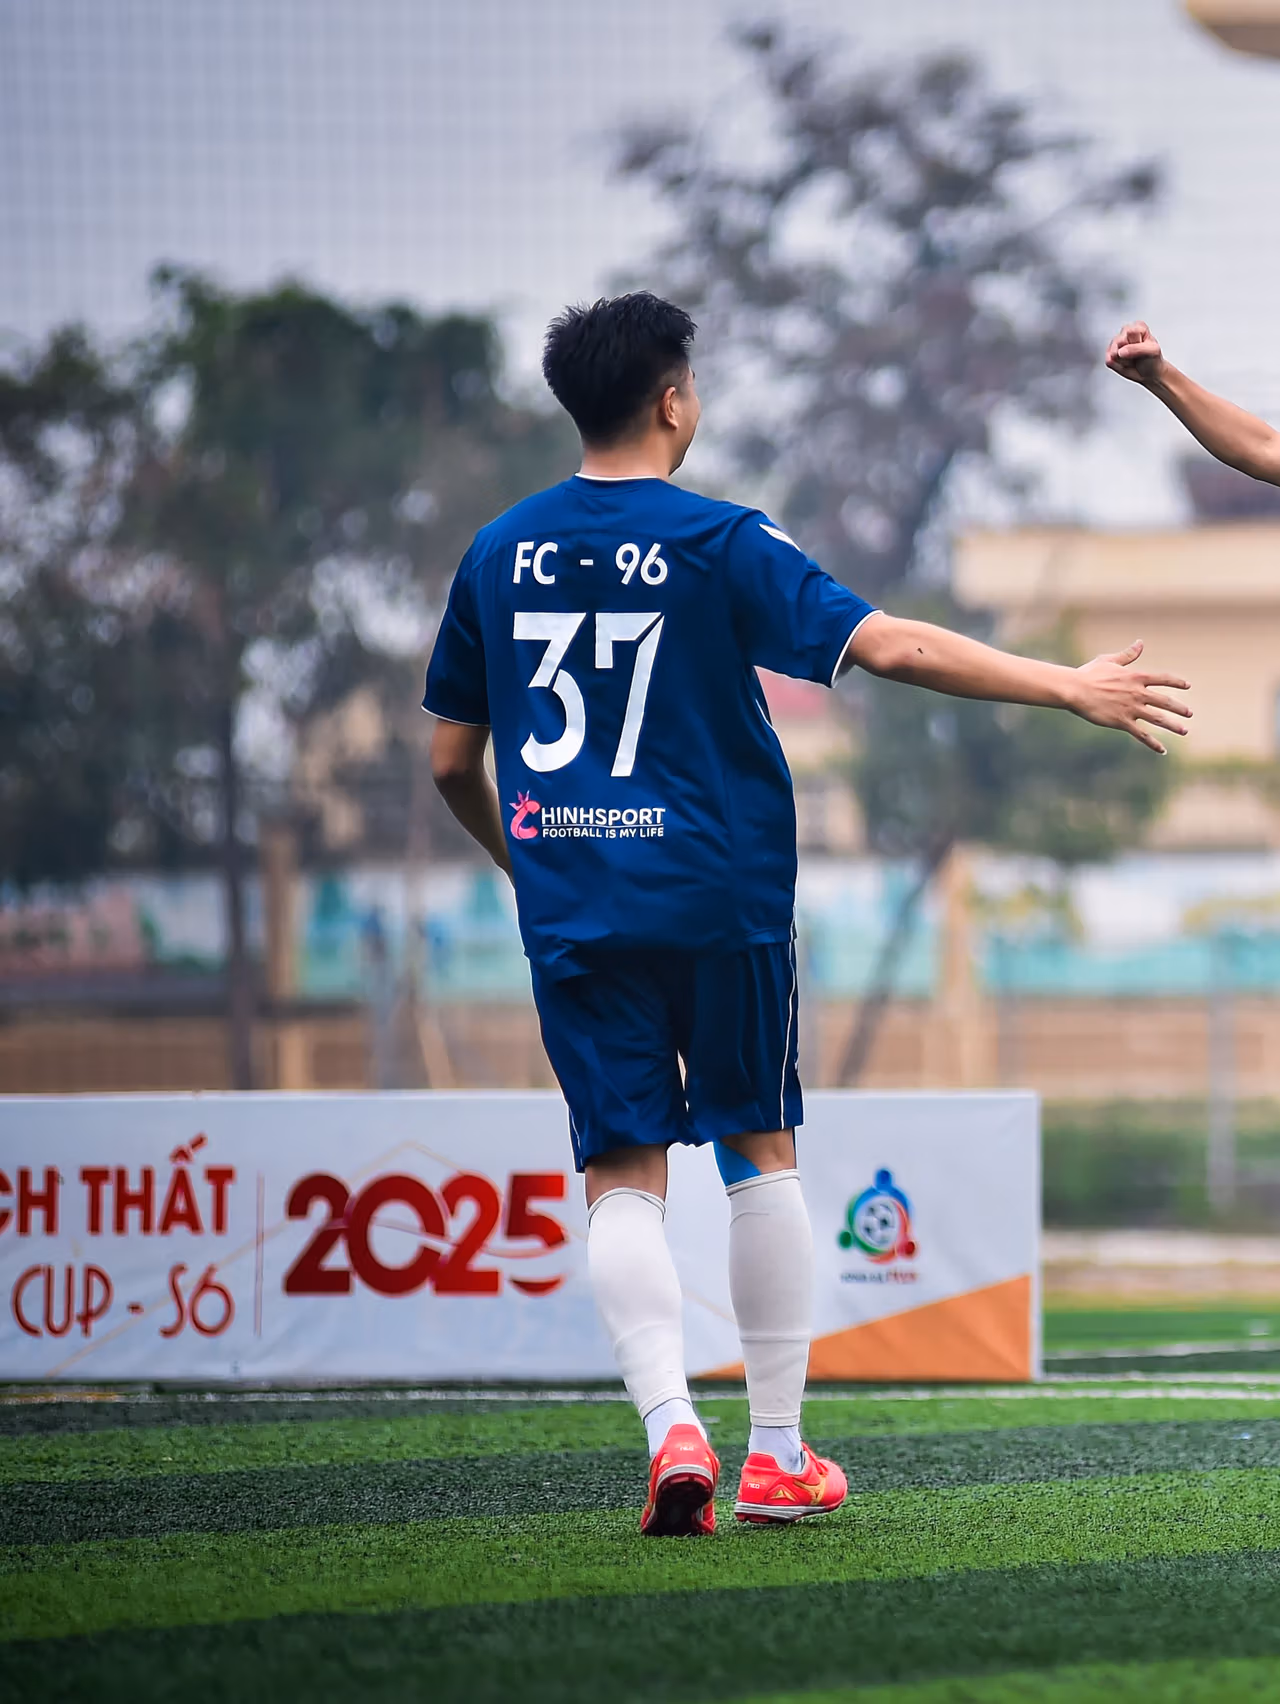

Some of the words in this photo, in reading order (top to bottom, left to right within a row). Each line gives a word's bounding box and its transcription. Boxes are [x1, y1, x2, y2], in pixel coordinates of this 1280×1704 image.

[512, 541, 558, 585] FC
[579, 558, 594, 566] -
[615, 542, 668, 585] 96
[512, 612, 665, 777] 37
[542, 827, 602, 839] FOOTBALL
[605, 828, 617, 839] IS
[619, 827, 637, 839] MY
[639, 826, 664, 838] LIFE
[0, 1164, 59, 1236] H
[79, 1132, 236, 1236] THẤT
[283, 1170, 569, 1298] 2025
[11, 1262, 114, 1338] CUP
[158, 1262, 236, 1338] S6
